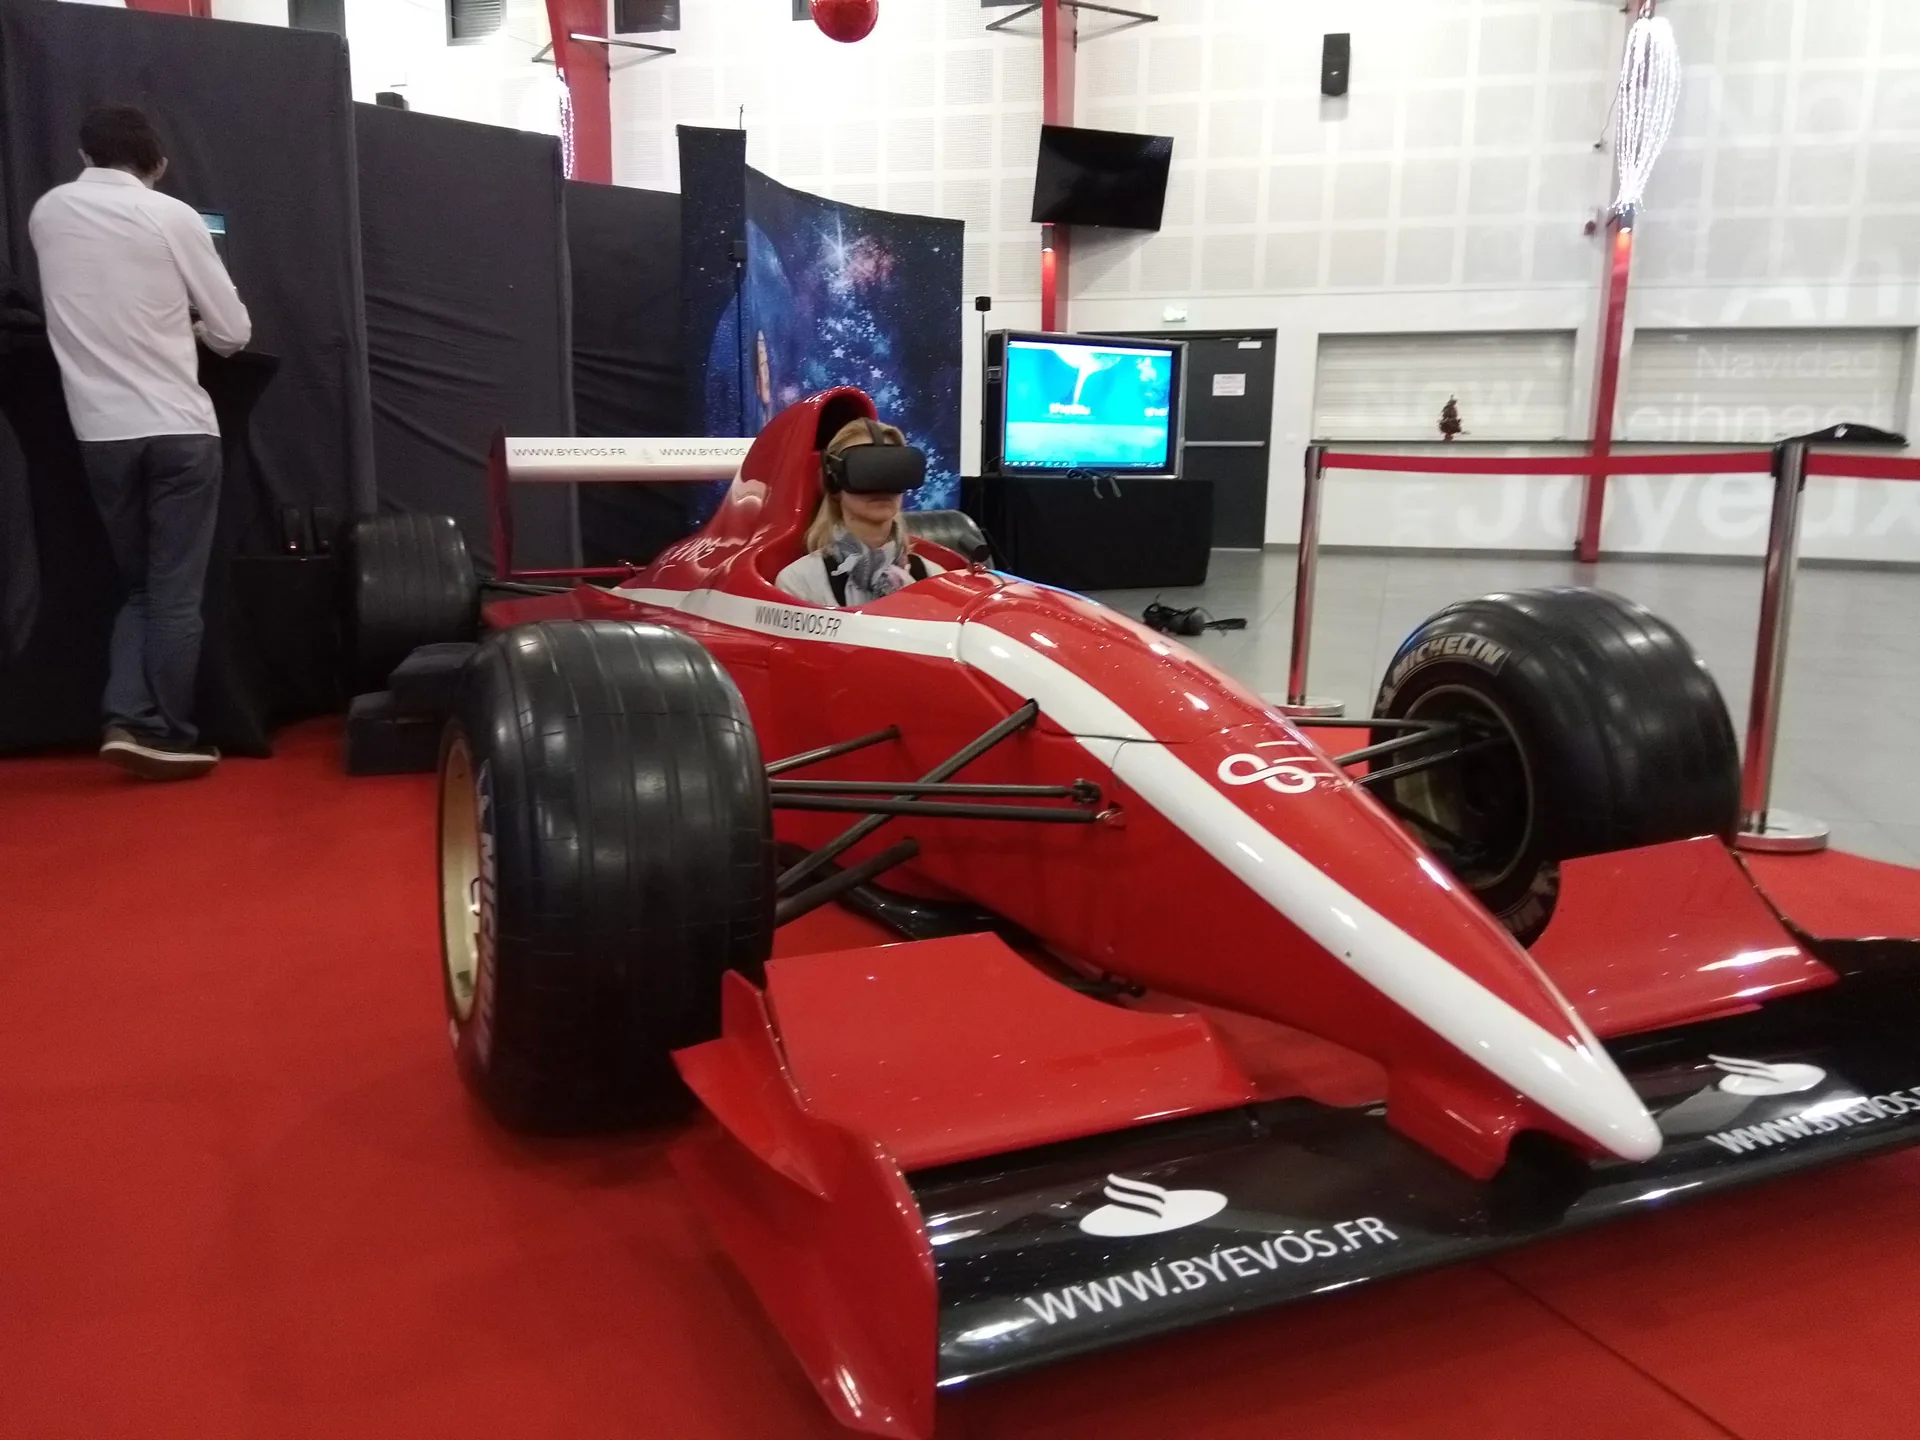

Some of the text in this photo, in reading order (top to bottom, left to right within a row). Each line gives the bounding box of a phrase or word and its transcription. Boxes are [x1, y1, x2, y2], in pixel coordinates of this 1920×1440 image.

[512, 447, 628, 457] WWW.BYEVOS.FR
[755, 605, 842, 637] WWW.BYEVOS.FR
[1393, 636, 1506, 684] MICHELIN
[1024, 1216, 1399, 1325] WWW.BYEVOS.FR
